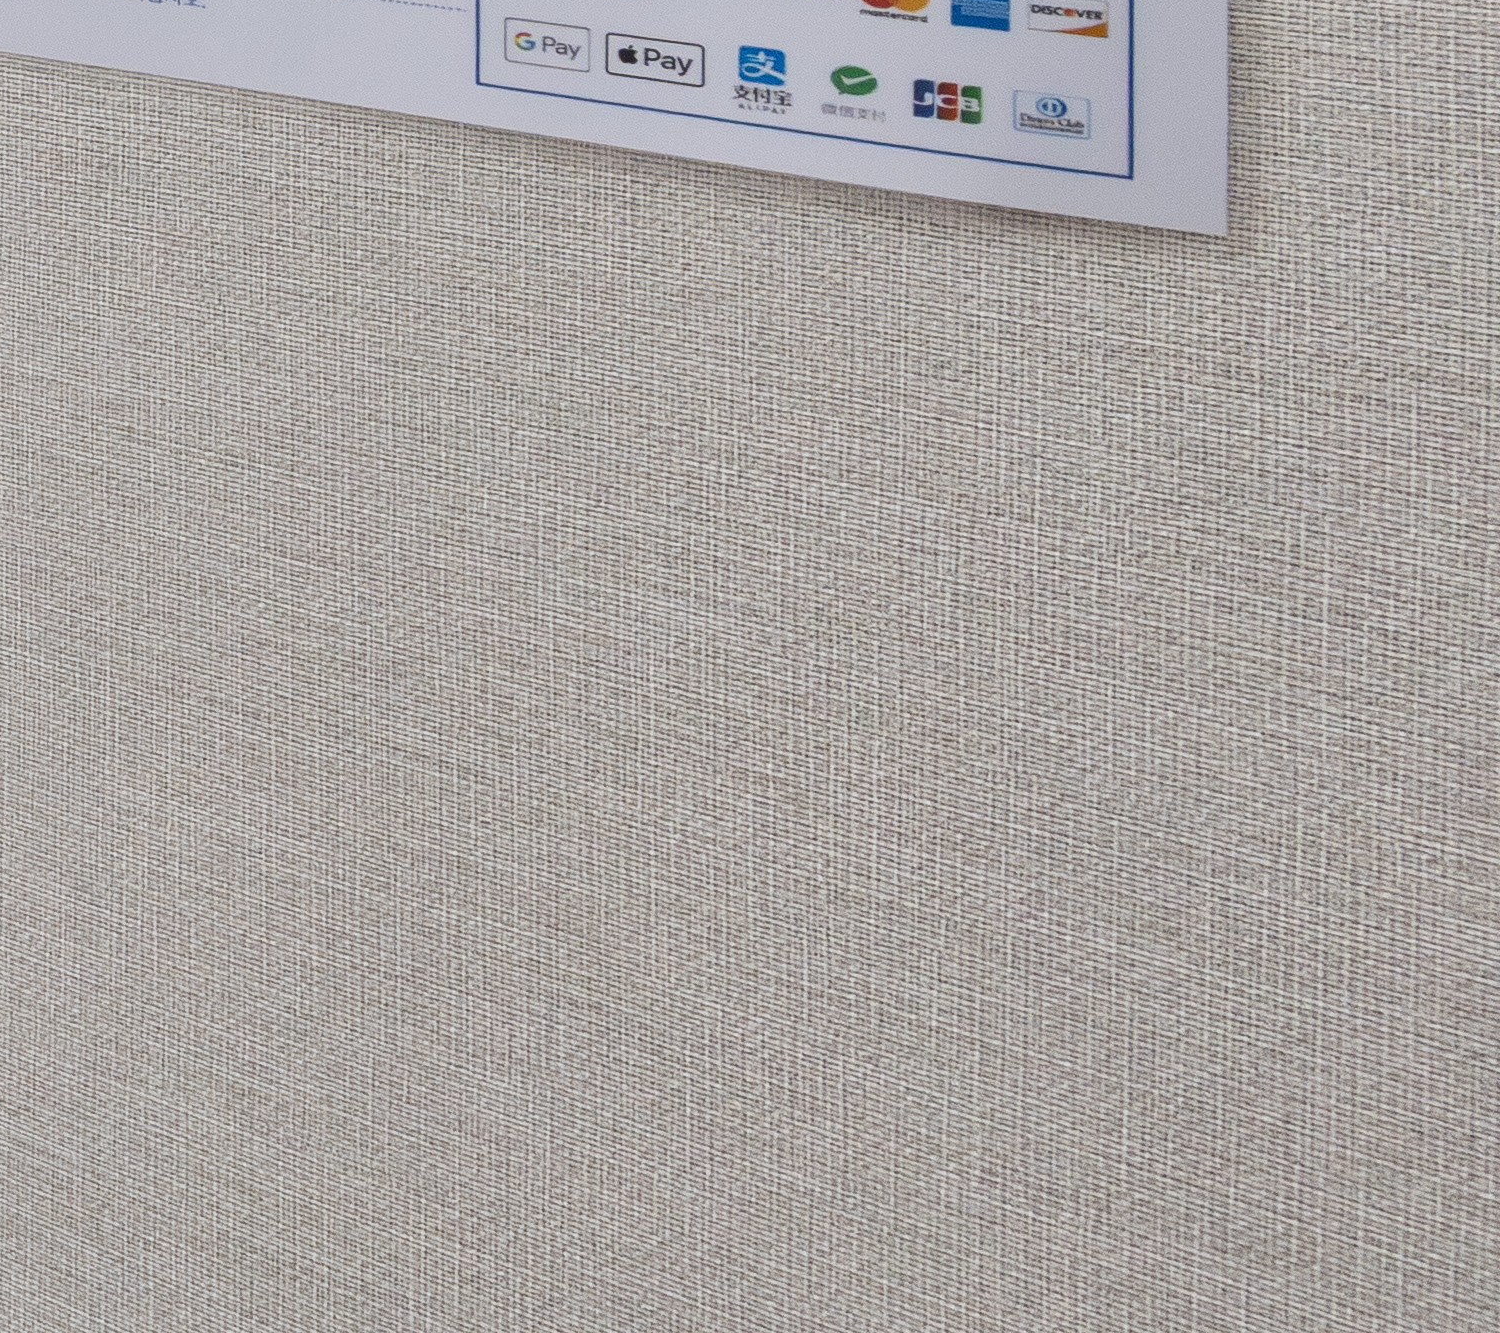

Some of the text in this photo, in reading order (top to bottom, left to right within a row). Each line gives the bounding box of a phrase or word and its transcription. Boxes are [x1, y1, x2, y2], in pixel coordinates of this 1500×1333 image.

[859, 8, 929, 24] mastercard
[1030, 2, 1104, 22] DISCOVER
[541, 36, 583, 61] Pay
[643, 47, 694, 77] Pay
[732, 84, 793, 108] 支付宝
